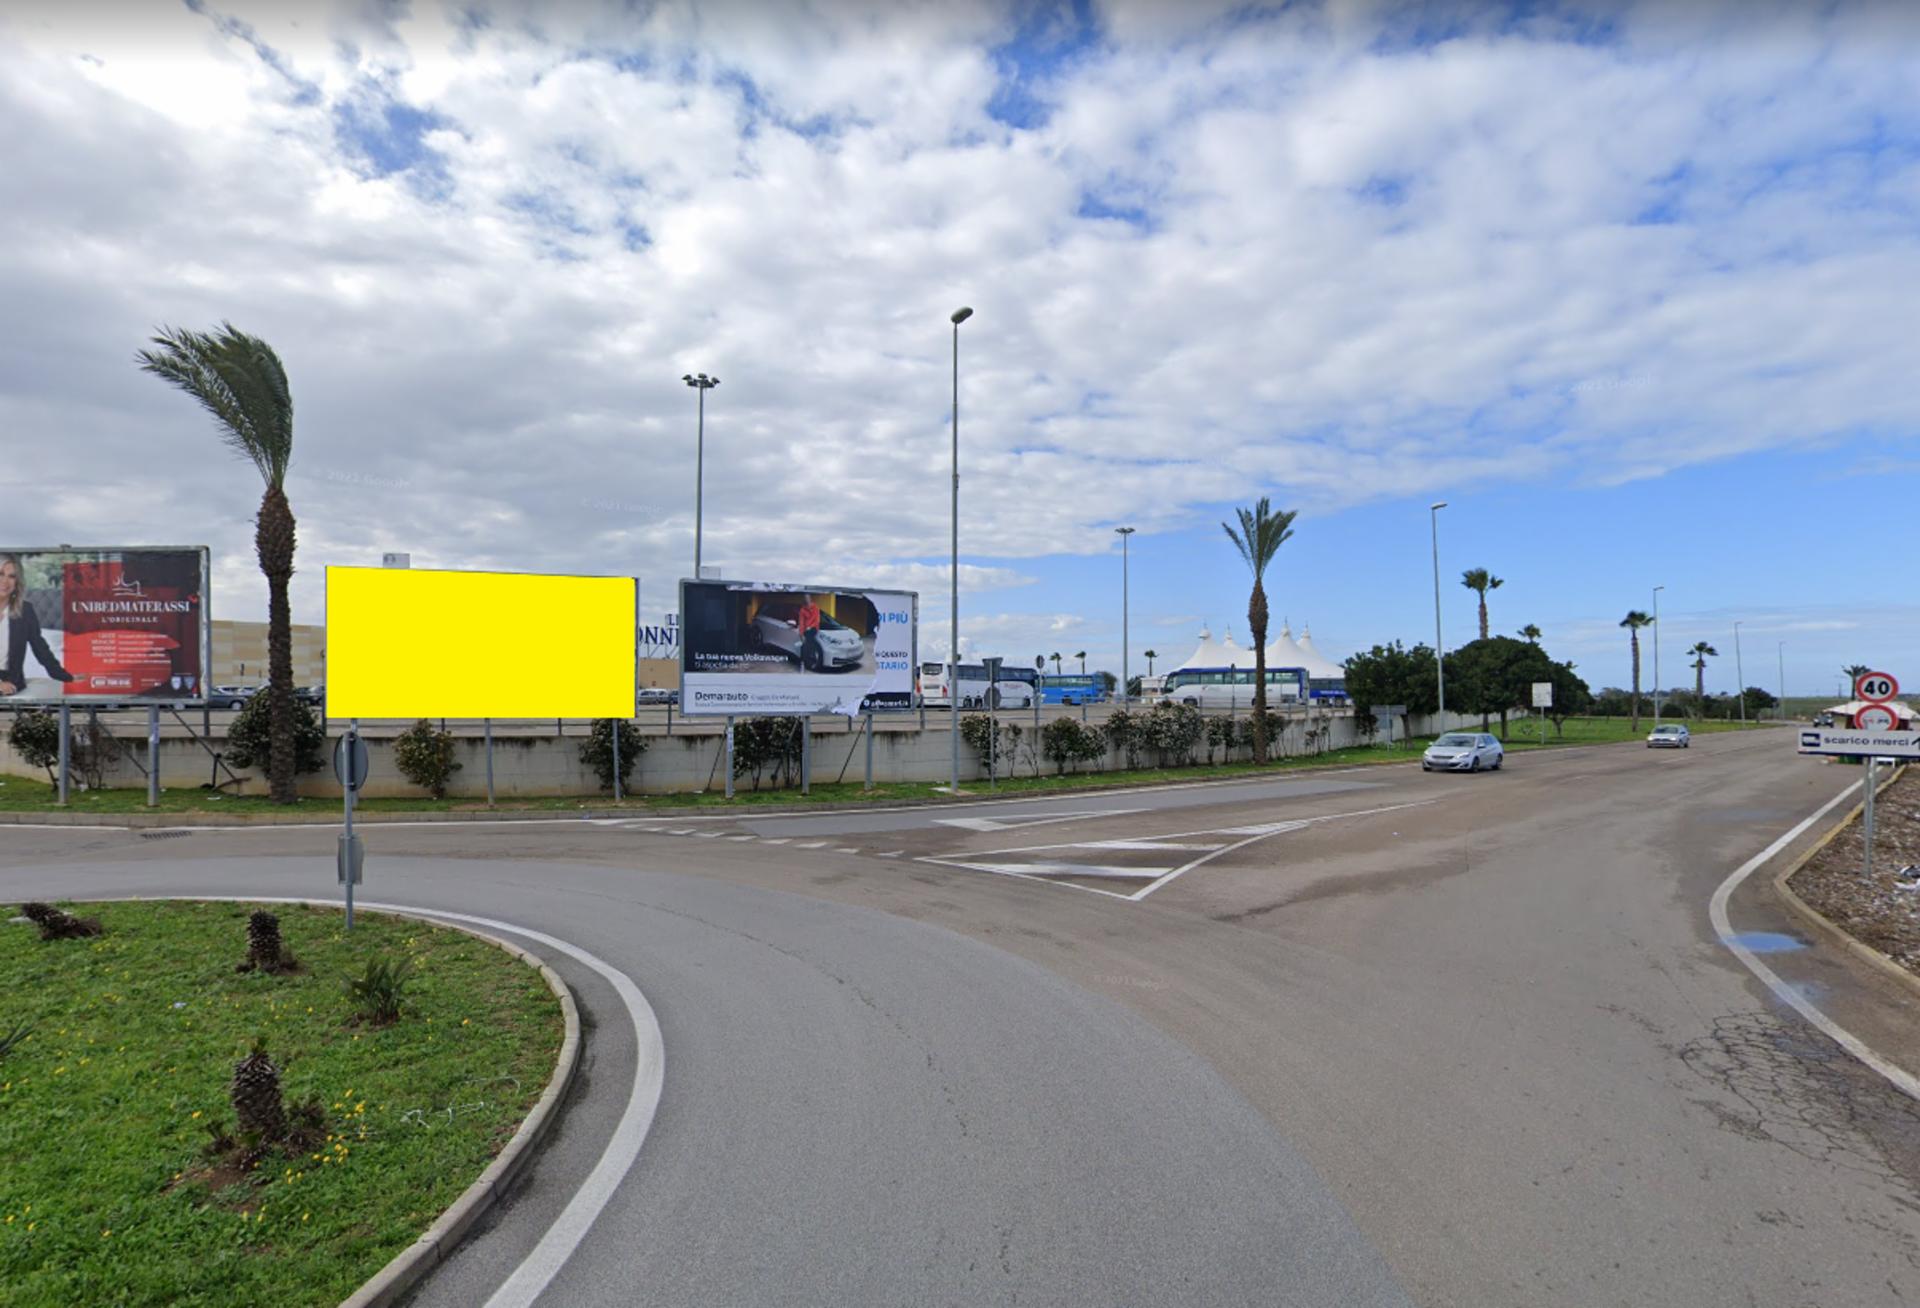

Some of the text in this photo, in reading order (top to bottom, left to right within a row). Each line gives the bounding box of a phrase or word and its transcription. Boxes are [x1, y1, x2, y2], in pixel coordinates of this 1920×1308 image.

[72, 600, 190, 613] UNIBEDMATERASSI
[888, 611, 908, 623] PIÙ
[1864, 680, 1890, 695] 40
[694, 691, 748, 701] Demarauto
[1824, 736, 1909, 746] scarico merci
